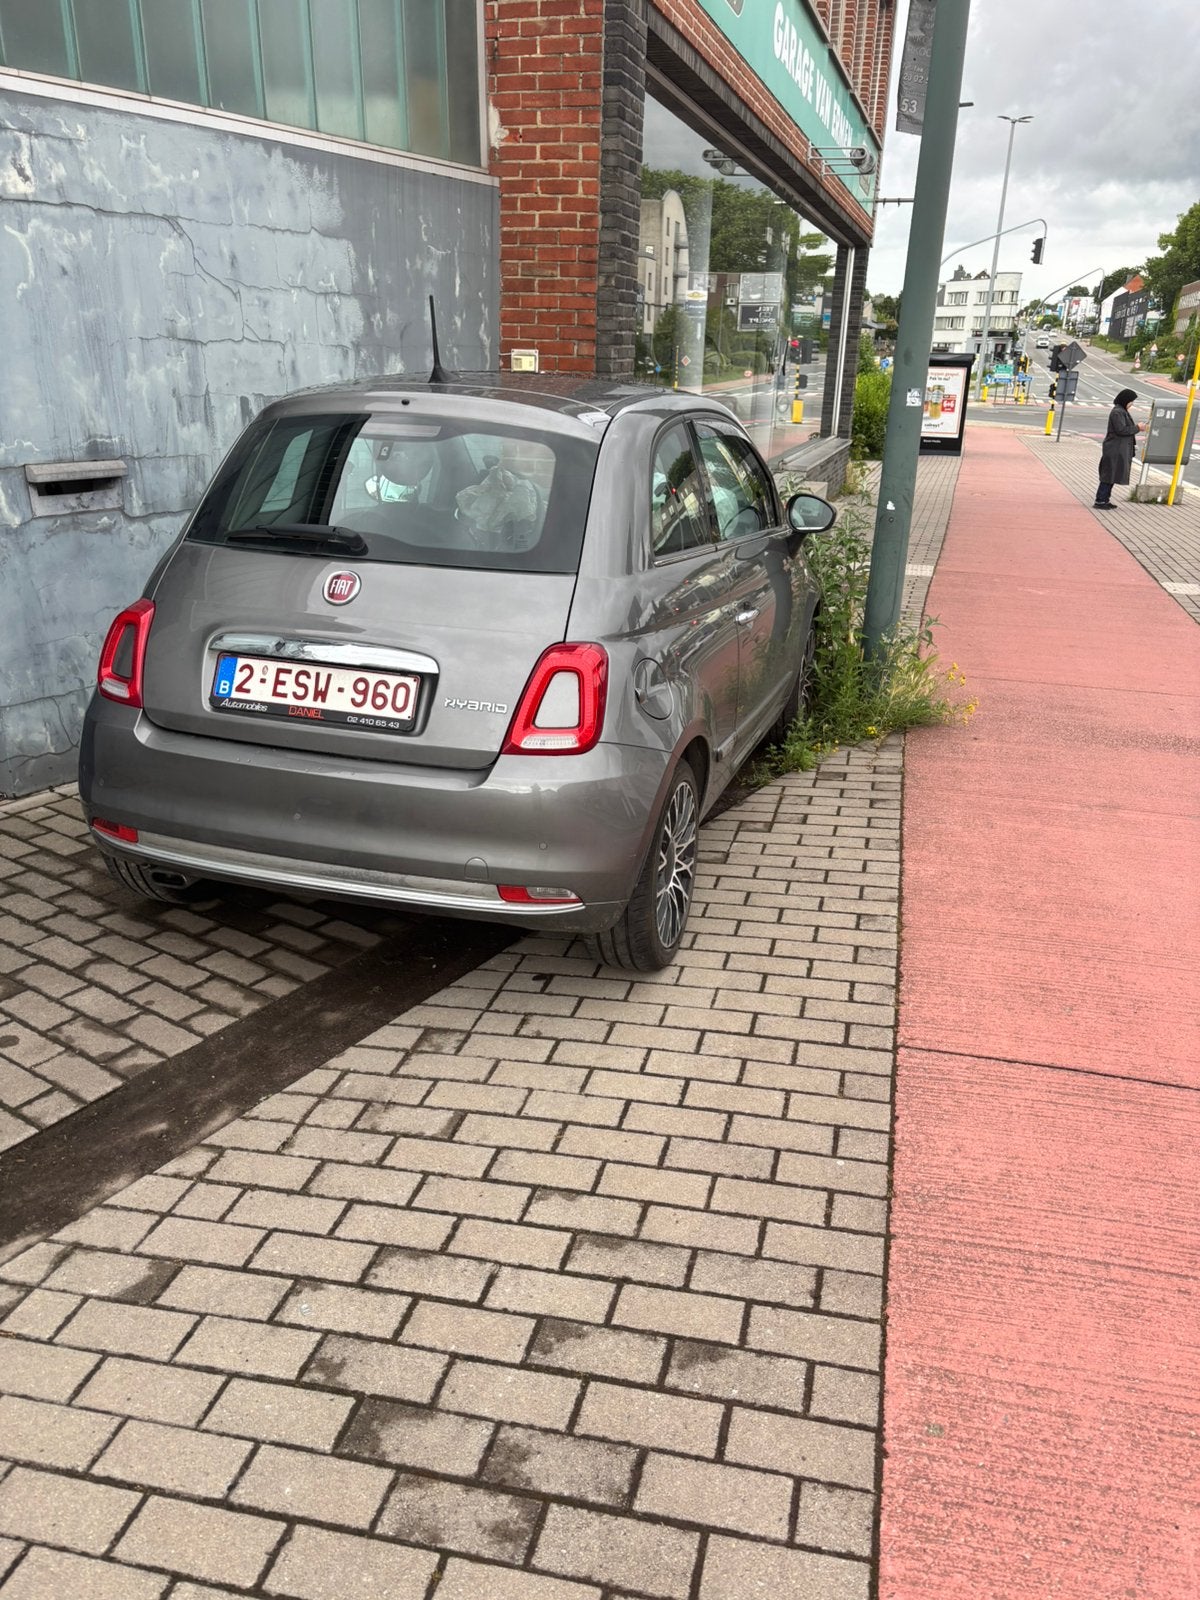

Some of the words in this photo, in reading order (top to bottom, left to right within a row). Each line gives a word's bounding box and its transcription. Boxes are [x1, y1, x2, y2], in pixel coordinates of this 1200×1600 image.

[773, 1, 815, 105] GARAGE
[815, 68, 833, 131] VAN
[900, 98, 918, 114] 53
[330, 579, 354, 595] FIAT
[219, 680, 230, 694] B
[235, 664, 411, 713] 2-ESW-960
[221, 698, 268, 712] Automobiles
[288, 705, 324, 719] DANIEL
[347, 715, 357, 724] 02
[359, 717, 375, 726] 410
[388, 720, 400, 729] 43
